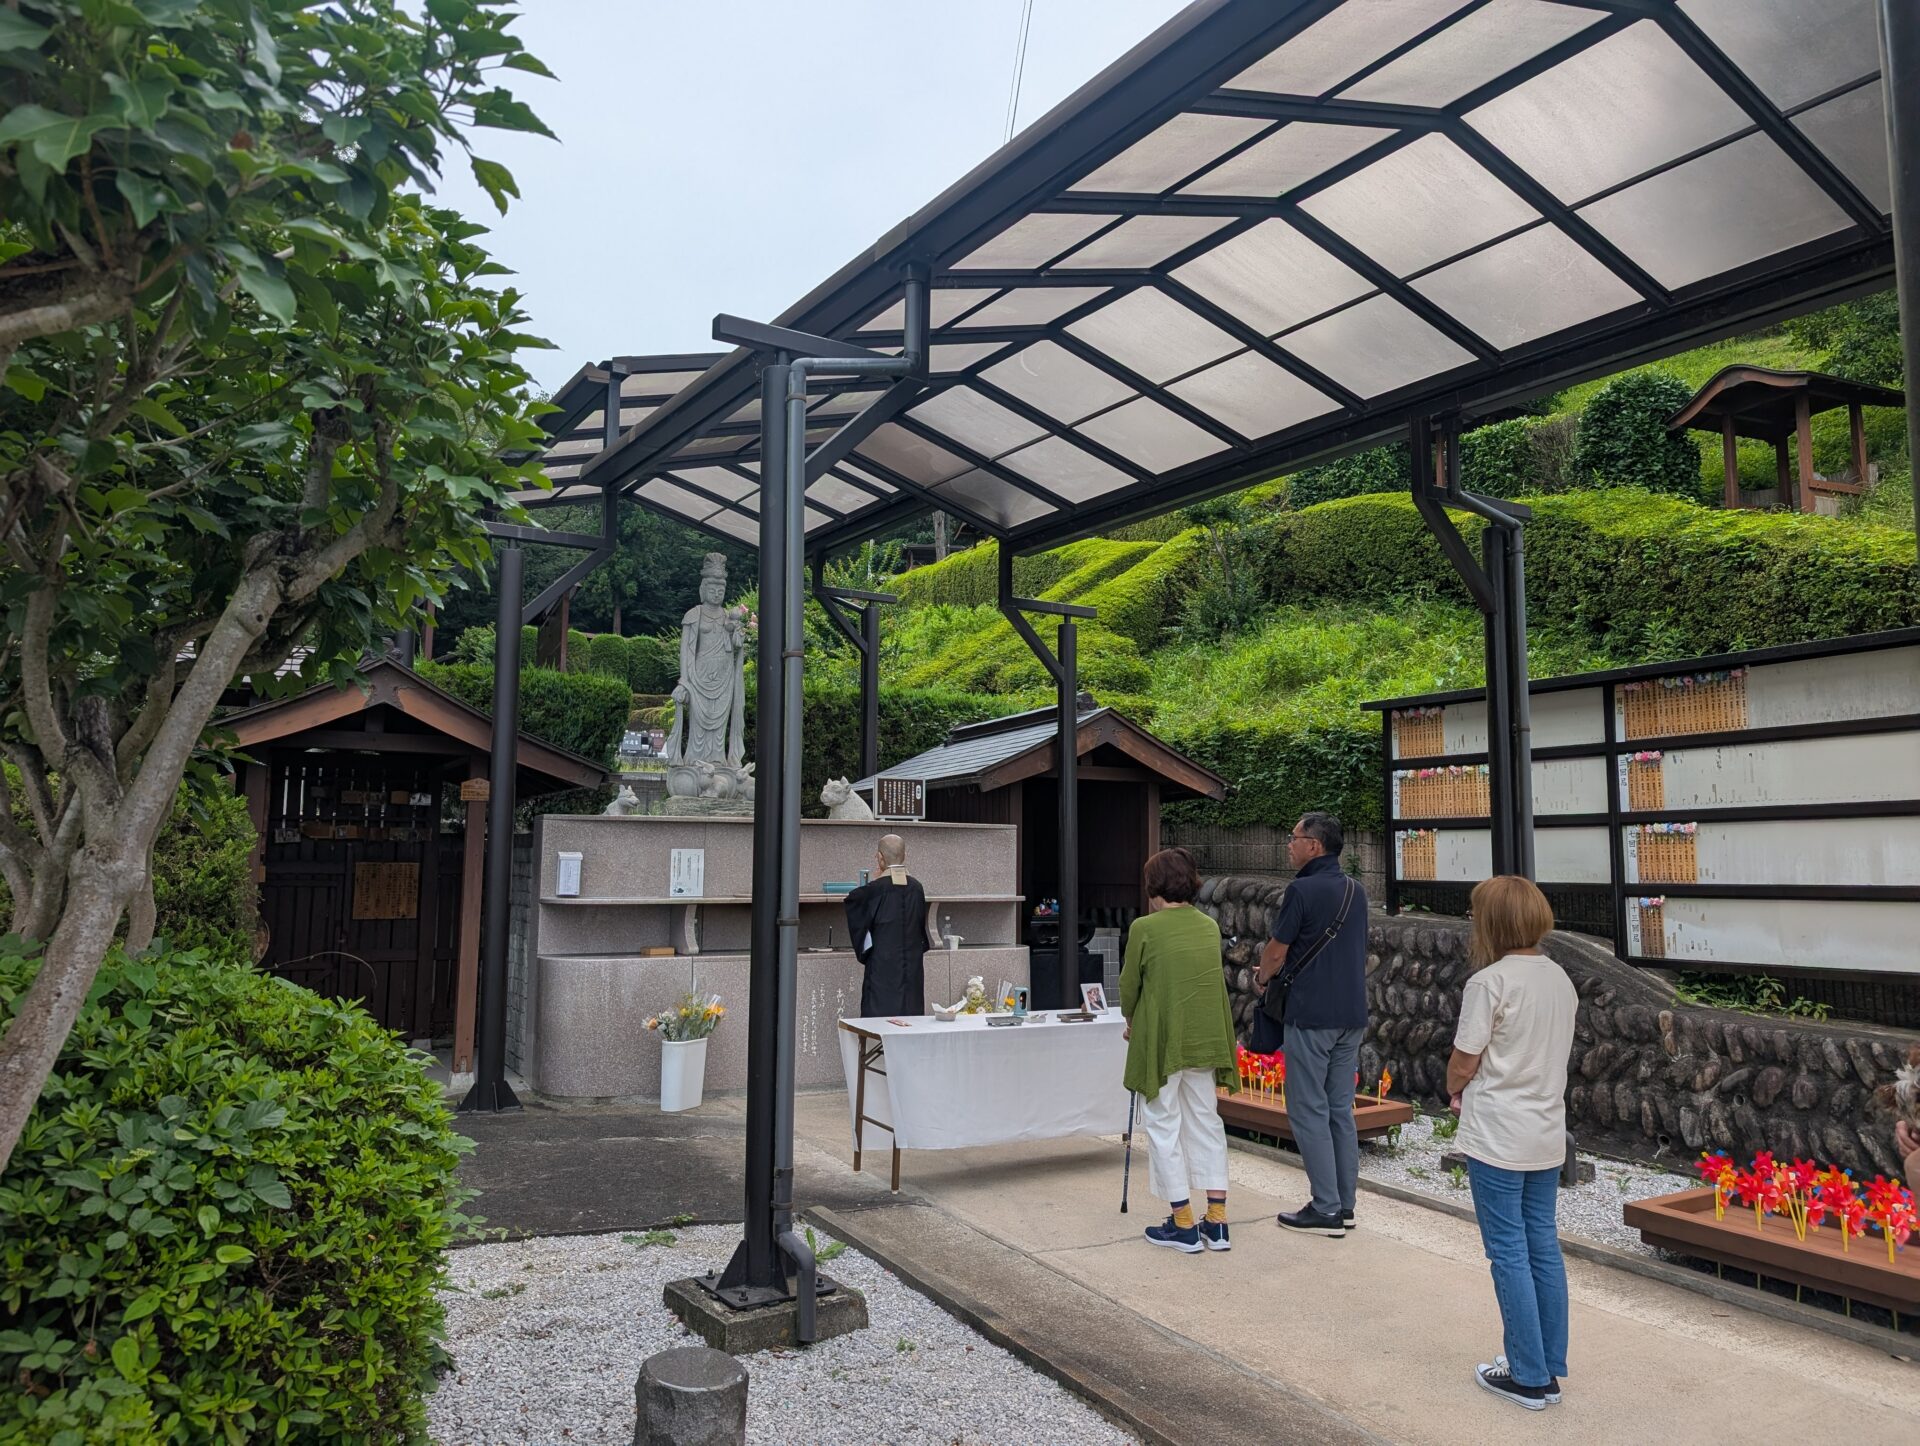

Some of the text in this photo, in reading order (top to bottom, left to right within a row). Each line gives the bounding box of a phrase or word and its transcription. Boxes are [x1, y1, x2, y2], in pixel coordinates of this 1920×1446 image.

[1619, 759, 1627, 787] 三回忌
[1628, 830, 1636, 858] 七回忌
[1631, 904, 1640, 943] 十三回忌
